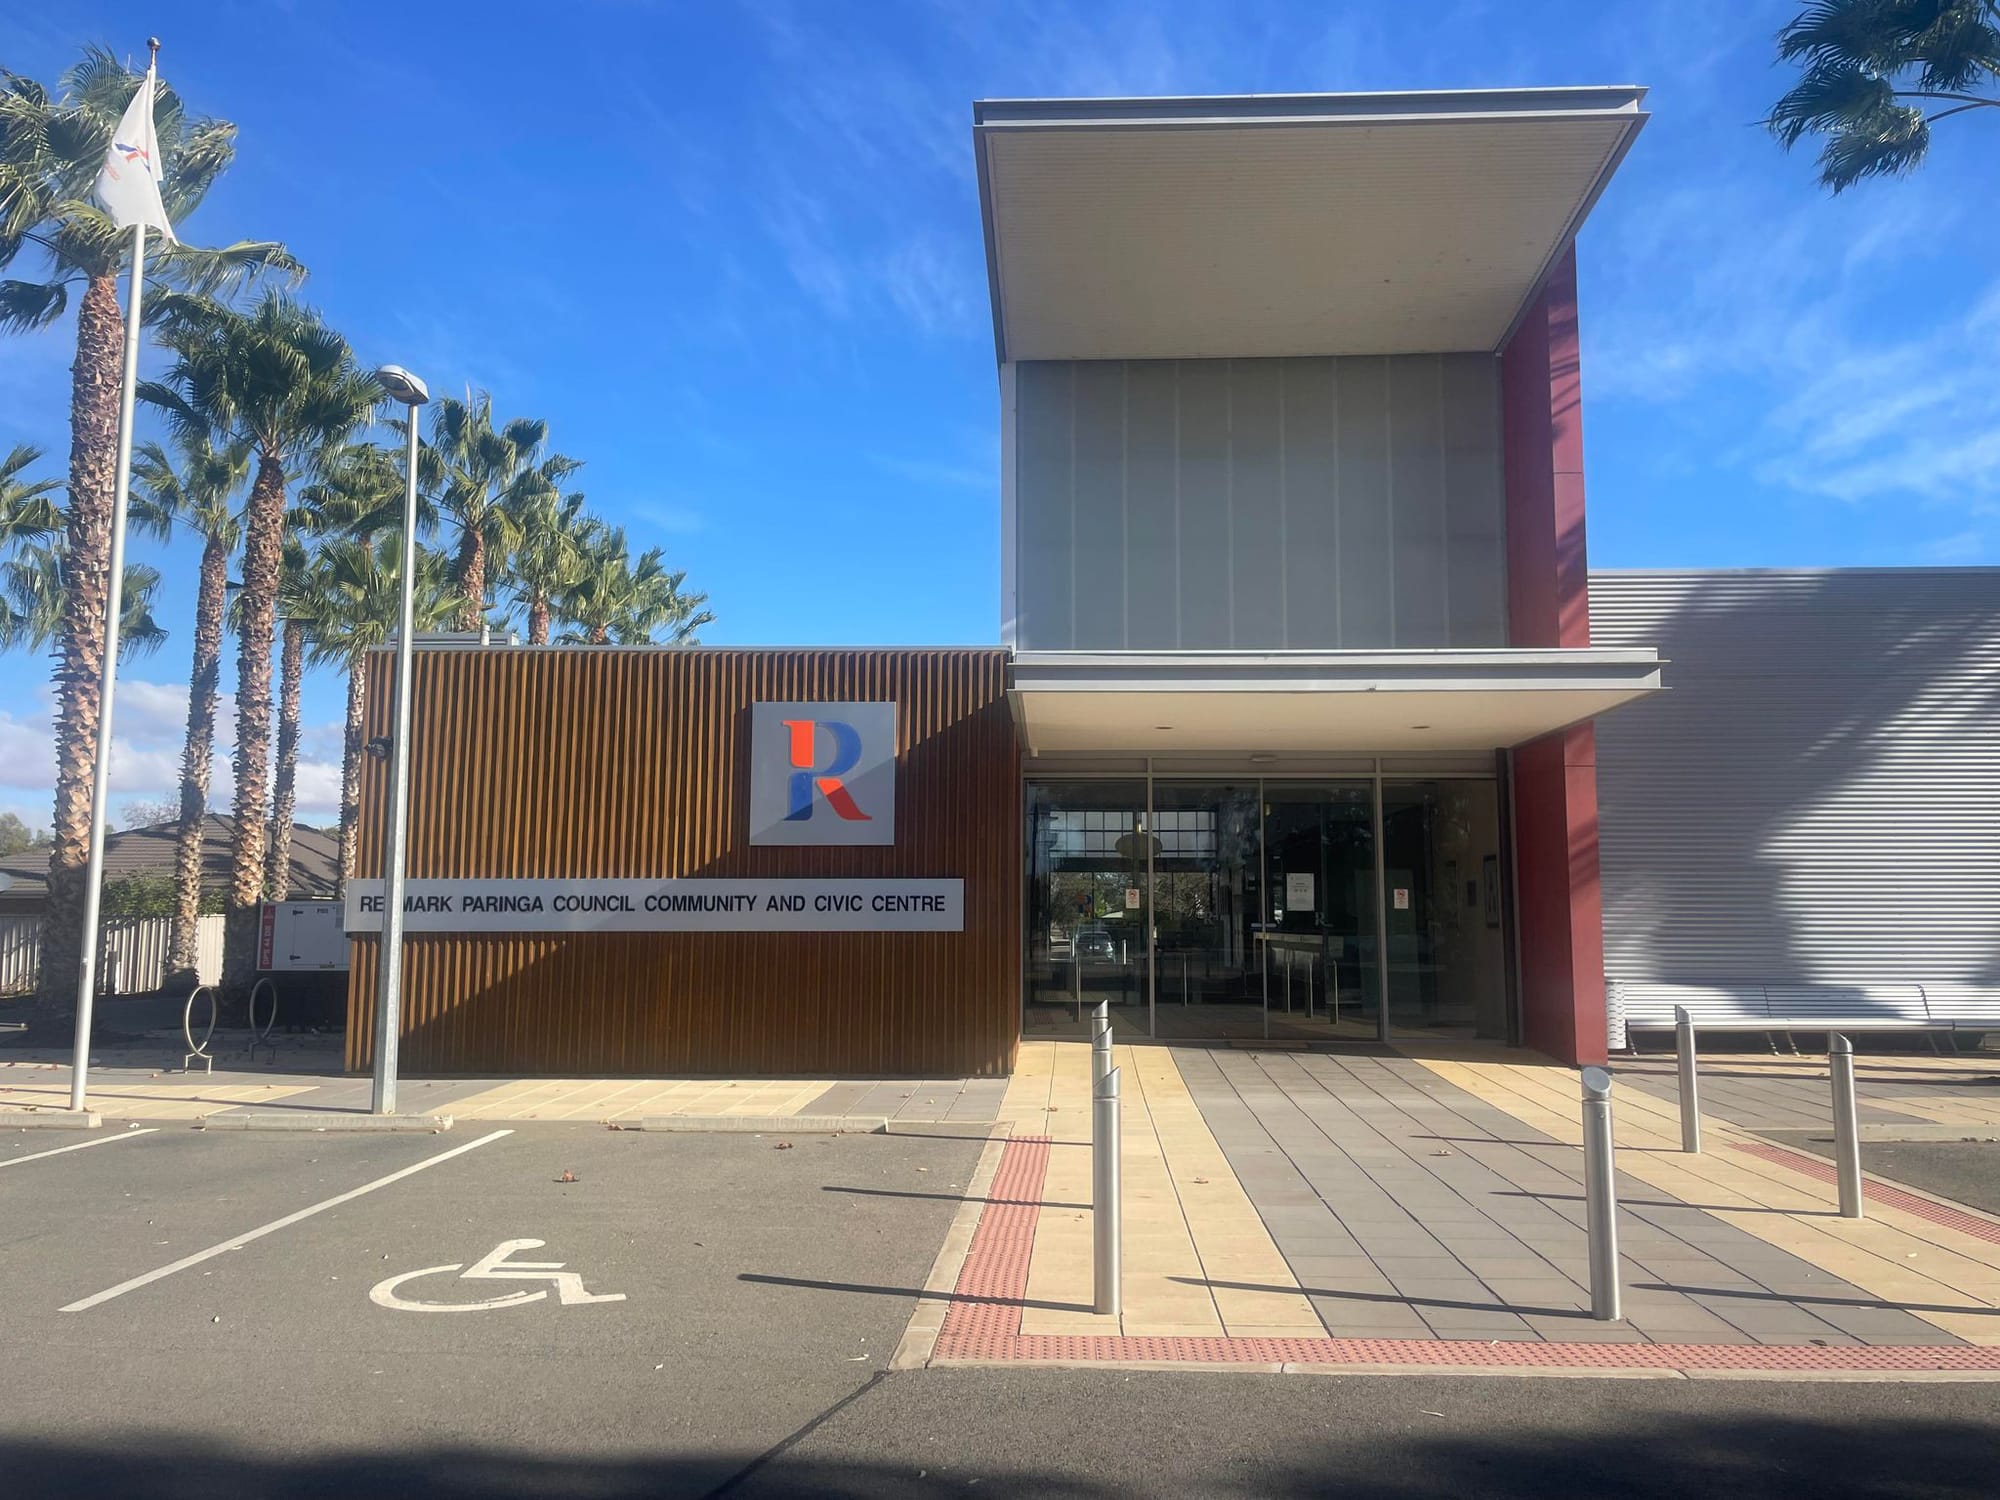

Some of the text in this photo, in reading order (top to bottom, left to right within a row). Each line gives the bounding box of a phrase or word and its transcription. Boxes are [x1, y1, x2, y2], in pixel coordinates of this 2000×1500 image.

[781, 719, 873, 821] R
[360, 895, 945, 912] REMARK PARINGA COUNCIL COMMUNITY AND CIVIC CENTRE
